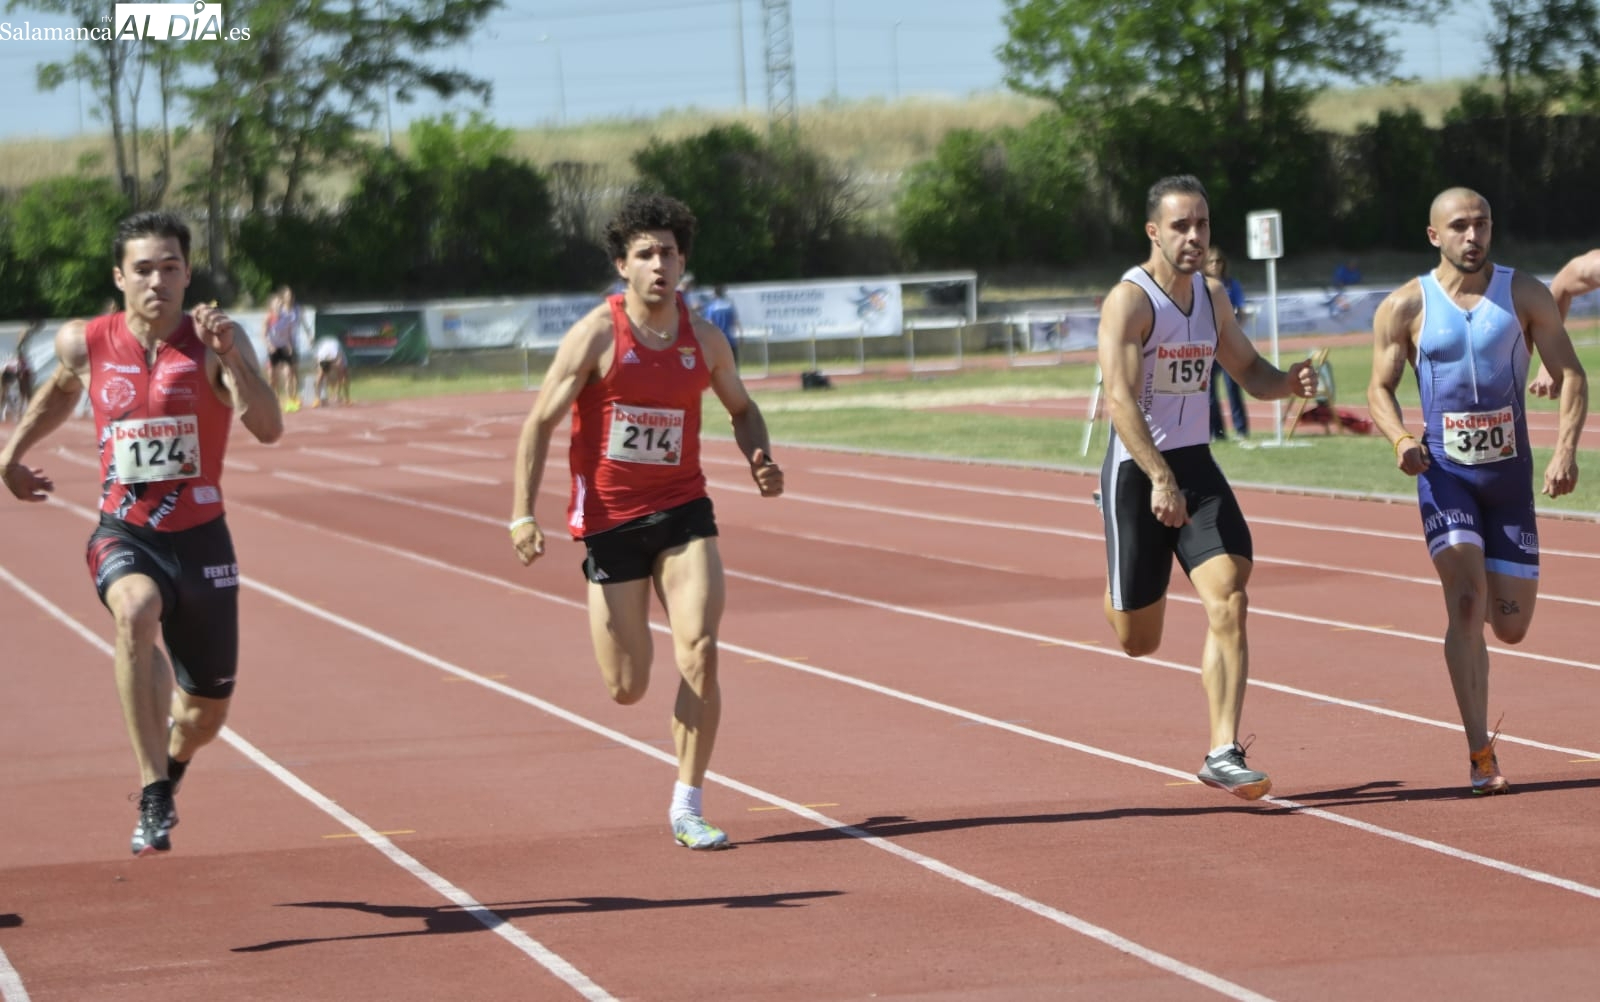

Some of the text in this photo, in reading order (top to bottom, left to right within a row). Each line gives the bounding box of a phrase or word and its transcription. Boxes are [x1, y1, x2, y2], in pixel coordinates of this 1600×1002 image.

[1158, 344, 1214, 359] bedunia
[1168, 359, 1206, 384] 159
[615, 408, 682, 428] bedunia
[1444, 410, 1513, 430] bedunia
[115, 420, 196, 442] bedunia
[623, 426, 672, 451] 214
[1456, 427, 1505, 453] 320
[129, 438, 187, 469] 124
[1446, 511, 1474, 526] JOAN
[204, 564, 230, 579] FENT
